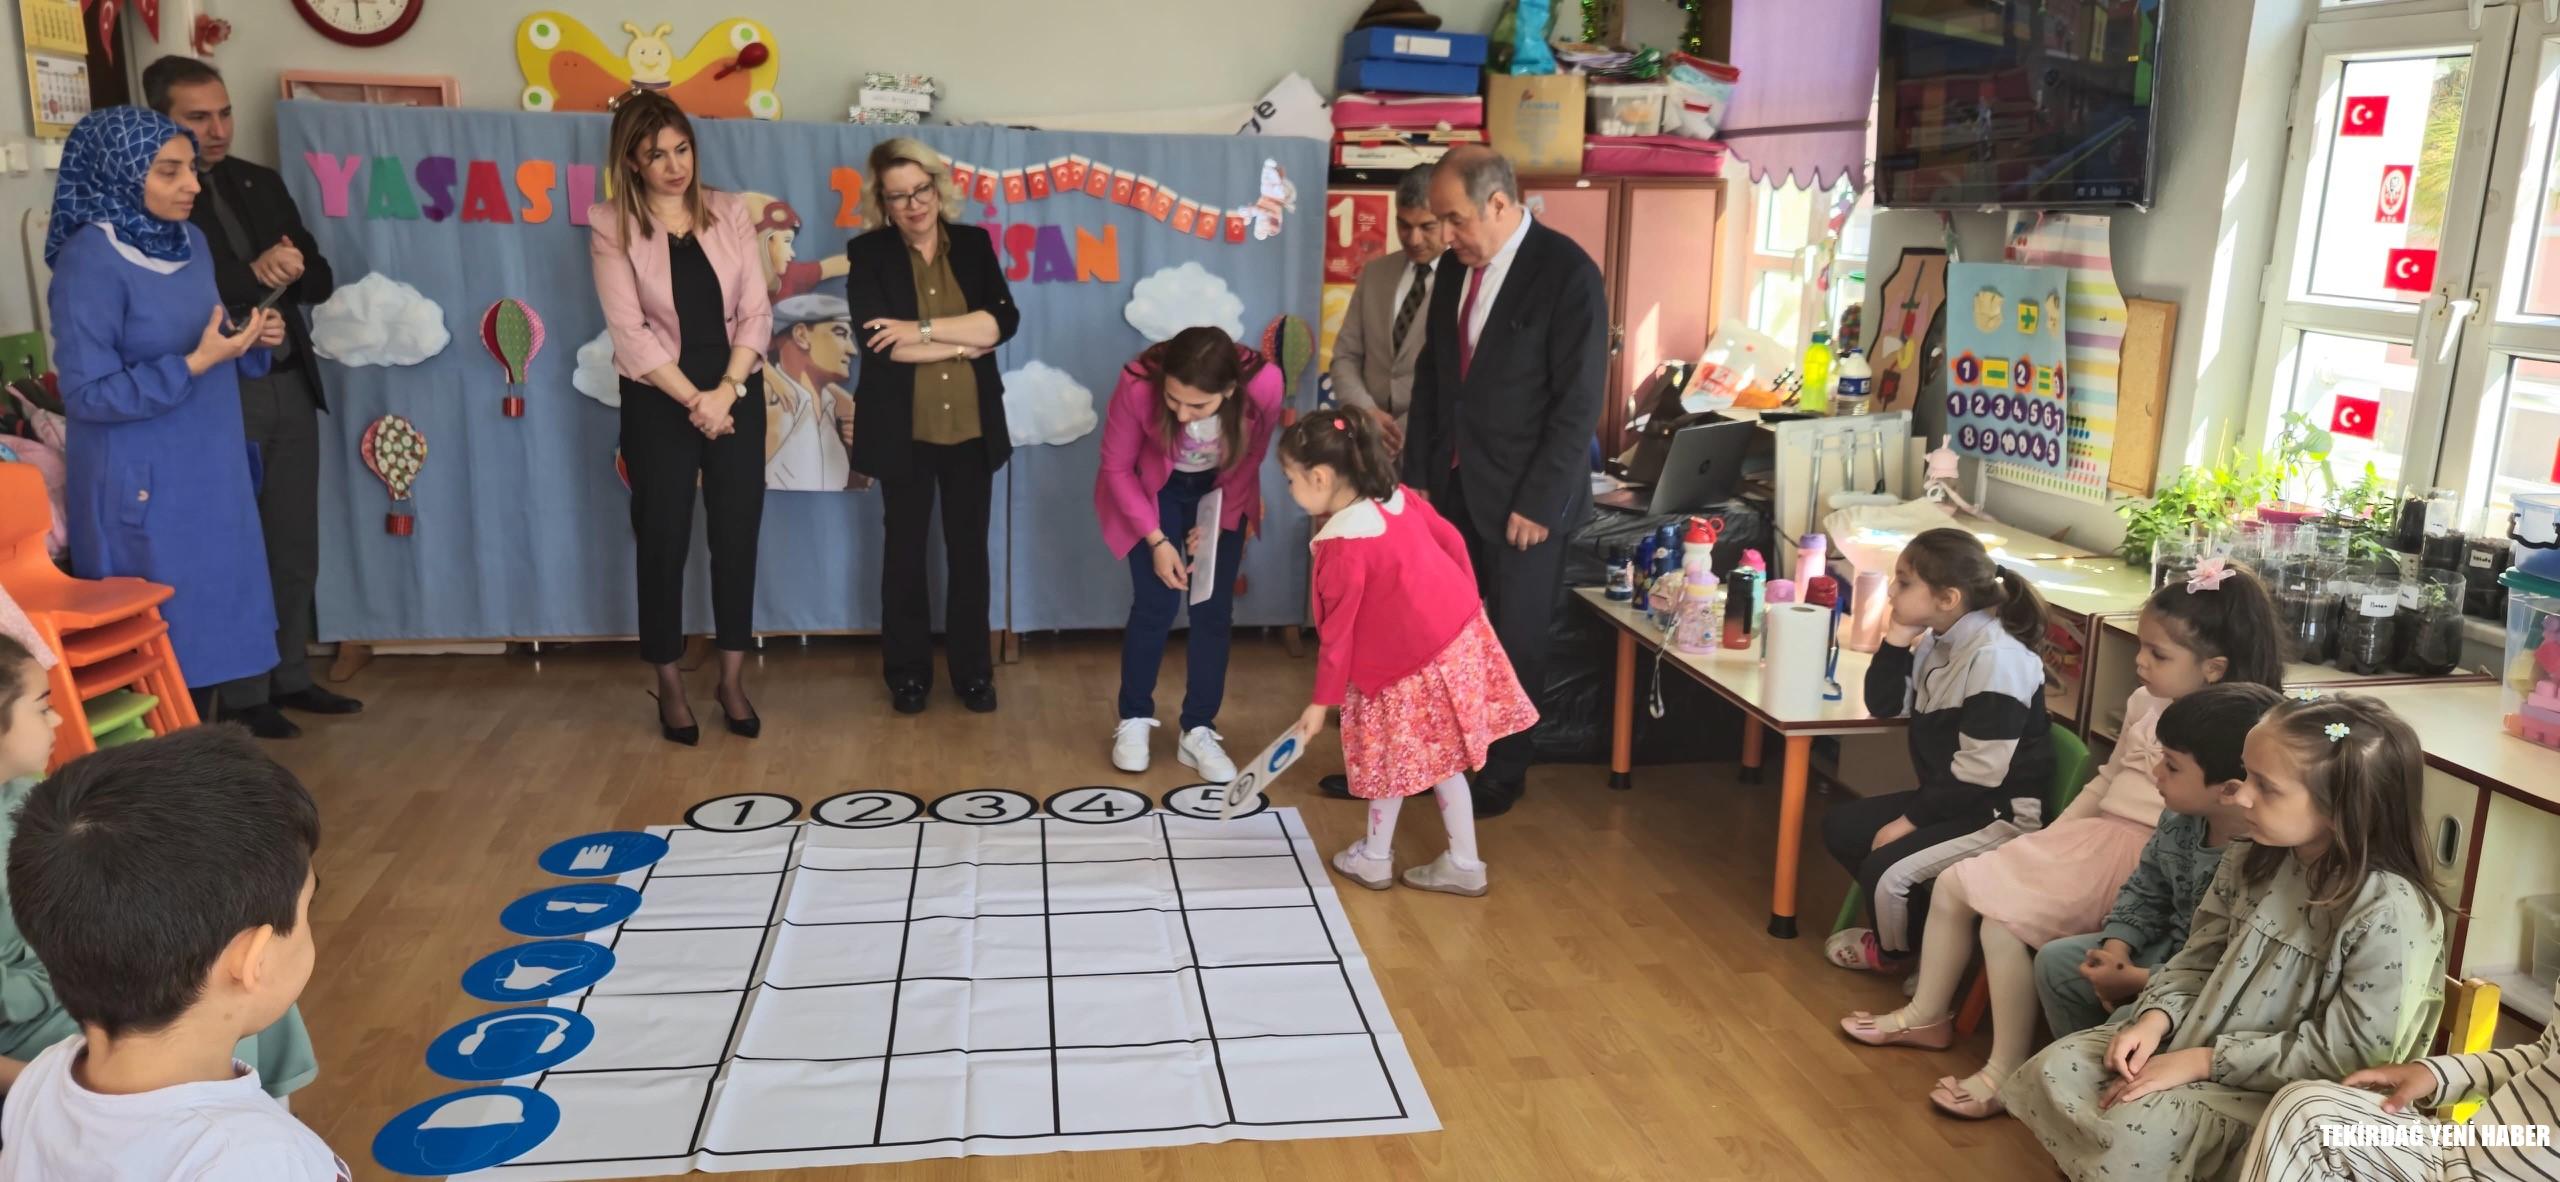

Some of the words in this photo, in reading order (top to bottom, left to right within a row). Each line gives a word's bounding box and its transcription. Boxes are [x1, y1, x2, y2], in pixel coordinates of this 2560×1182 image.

[1329, 197, 1354, 248] 1
[1963, 360, 1971, 379] 1
[2017, 363, 2026, 385] 2
[1951, 395, 1960, 415] 1
[1974, 395, 1985, 415] 2
[1995, 398, 2005, 416] 3
[2013, 401, 2022, 420] 4
[2030, 403, 2038, 422] 5
[2044, 406, 2052, 427] 6
[1964, 427, 1974, 446] 8
[1982, 431, 1993, 451] 9
[2032, 438, 2041, 457] 4
[2048, 444, 2056, 462] 5
[734, 800, 756, 825] 1
[845, 797, 894, 823] 2
[965, 795, 1007, 819] 3
[1069, 793, 1124, 817] 4
